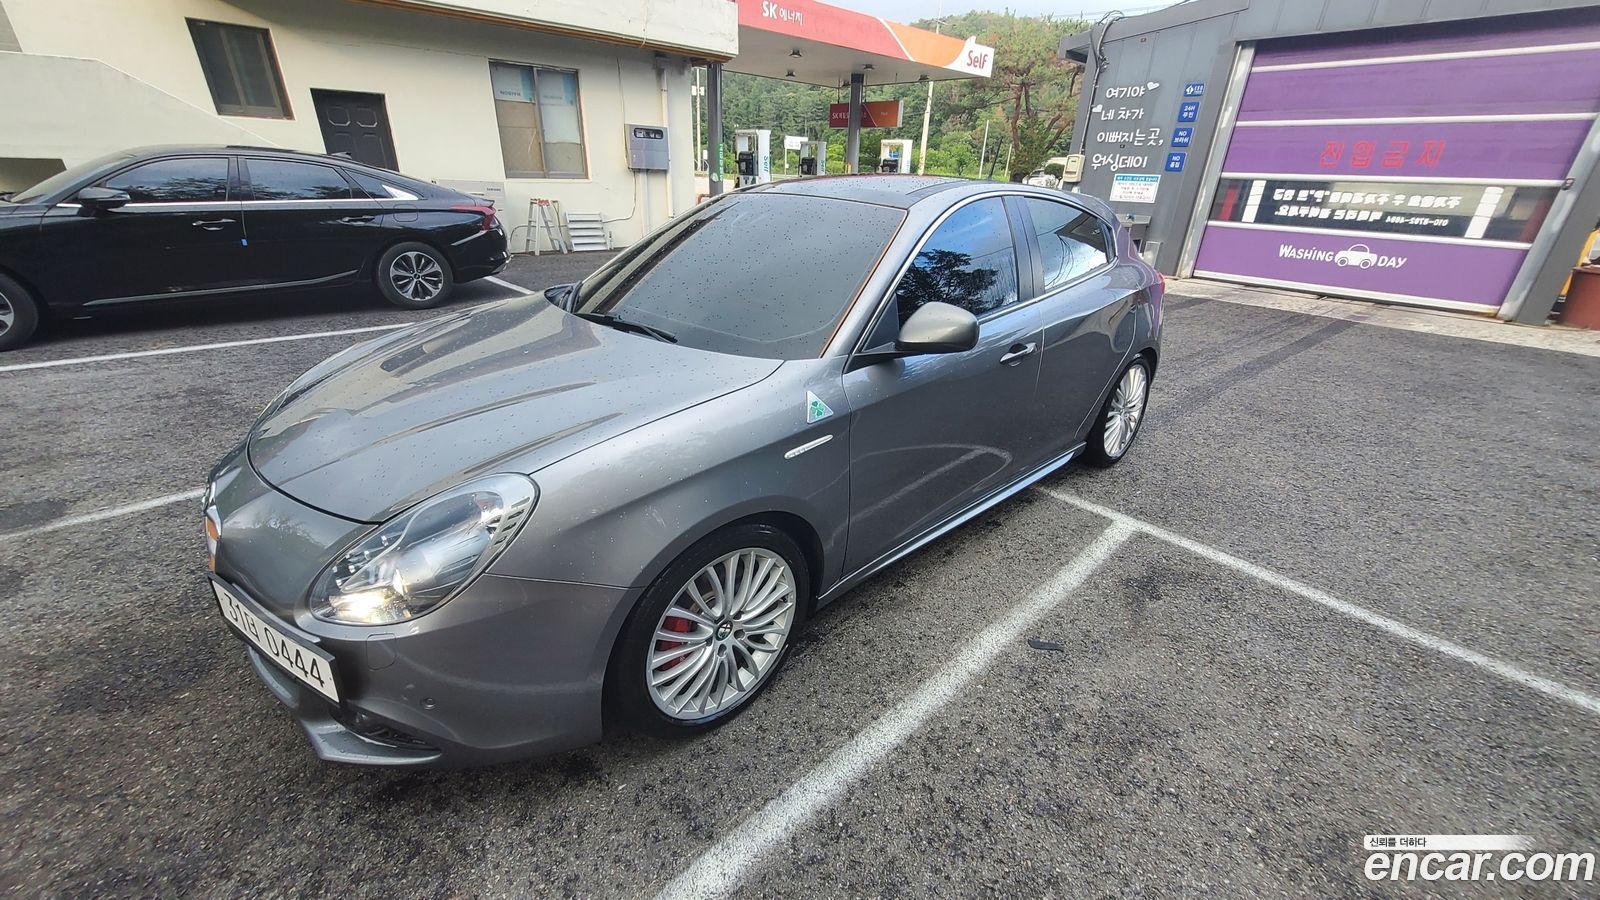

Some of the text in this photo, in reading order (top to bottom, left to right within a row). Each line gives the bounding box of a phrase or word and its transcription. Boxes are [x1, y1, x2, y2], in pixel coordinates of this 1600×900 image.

[762, 0, 804, 26] SK 에너지
[966, 50, 989, 70] Self
[1106, 86, 1146, 98] 여기야
[1101, 107, 1144, 121] 네 차가
[1091, 153, 1148, 172] 워싱데이
[1378, 255, 1408, 269] DAY
[223, 592, 325, 688] 31더 0444
